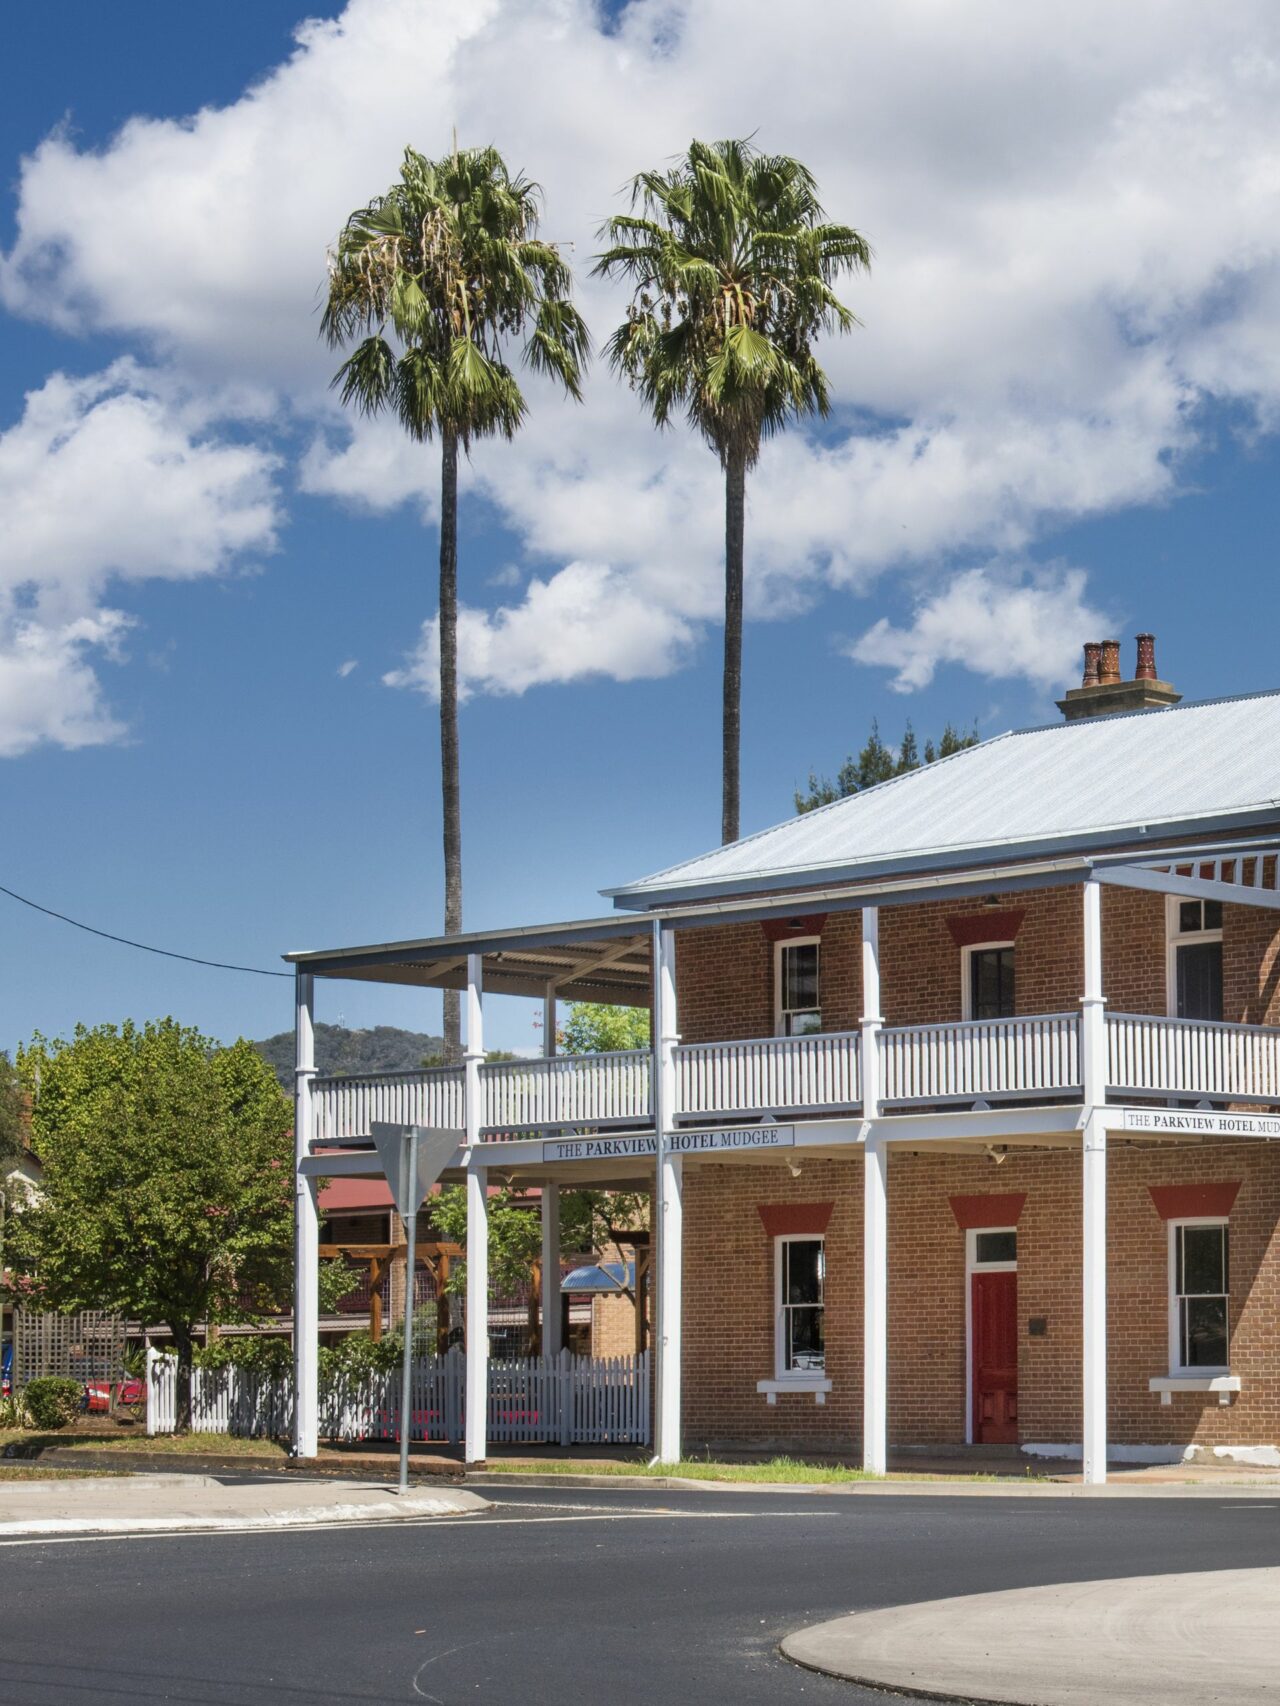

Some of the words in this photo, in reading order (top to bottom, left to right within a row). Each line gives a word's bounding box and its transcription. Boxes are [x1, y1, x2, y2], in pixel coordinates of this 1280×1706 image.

[1128, 1114, 1151, 1127] THE
[1153, 1115, 1215, 1130] PARKVIEW
[1219, 1119, 1256, 1132] HOTEL
[557, 1143, 583, 1158] THE
[585, 1137, 657, 1156] PARKVIEW
[670, 1133, 718, 1150] HOTEL
[720, 1129, 779, 1147] MUDGEE
